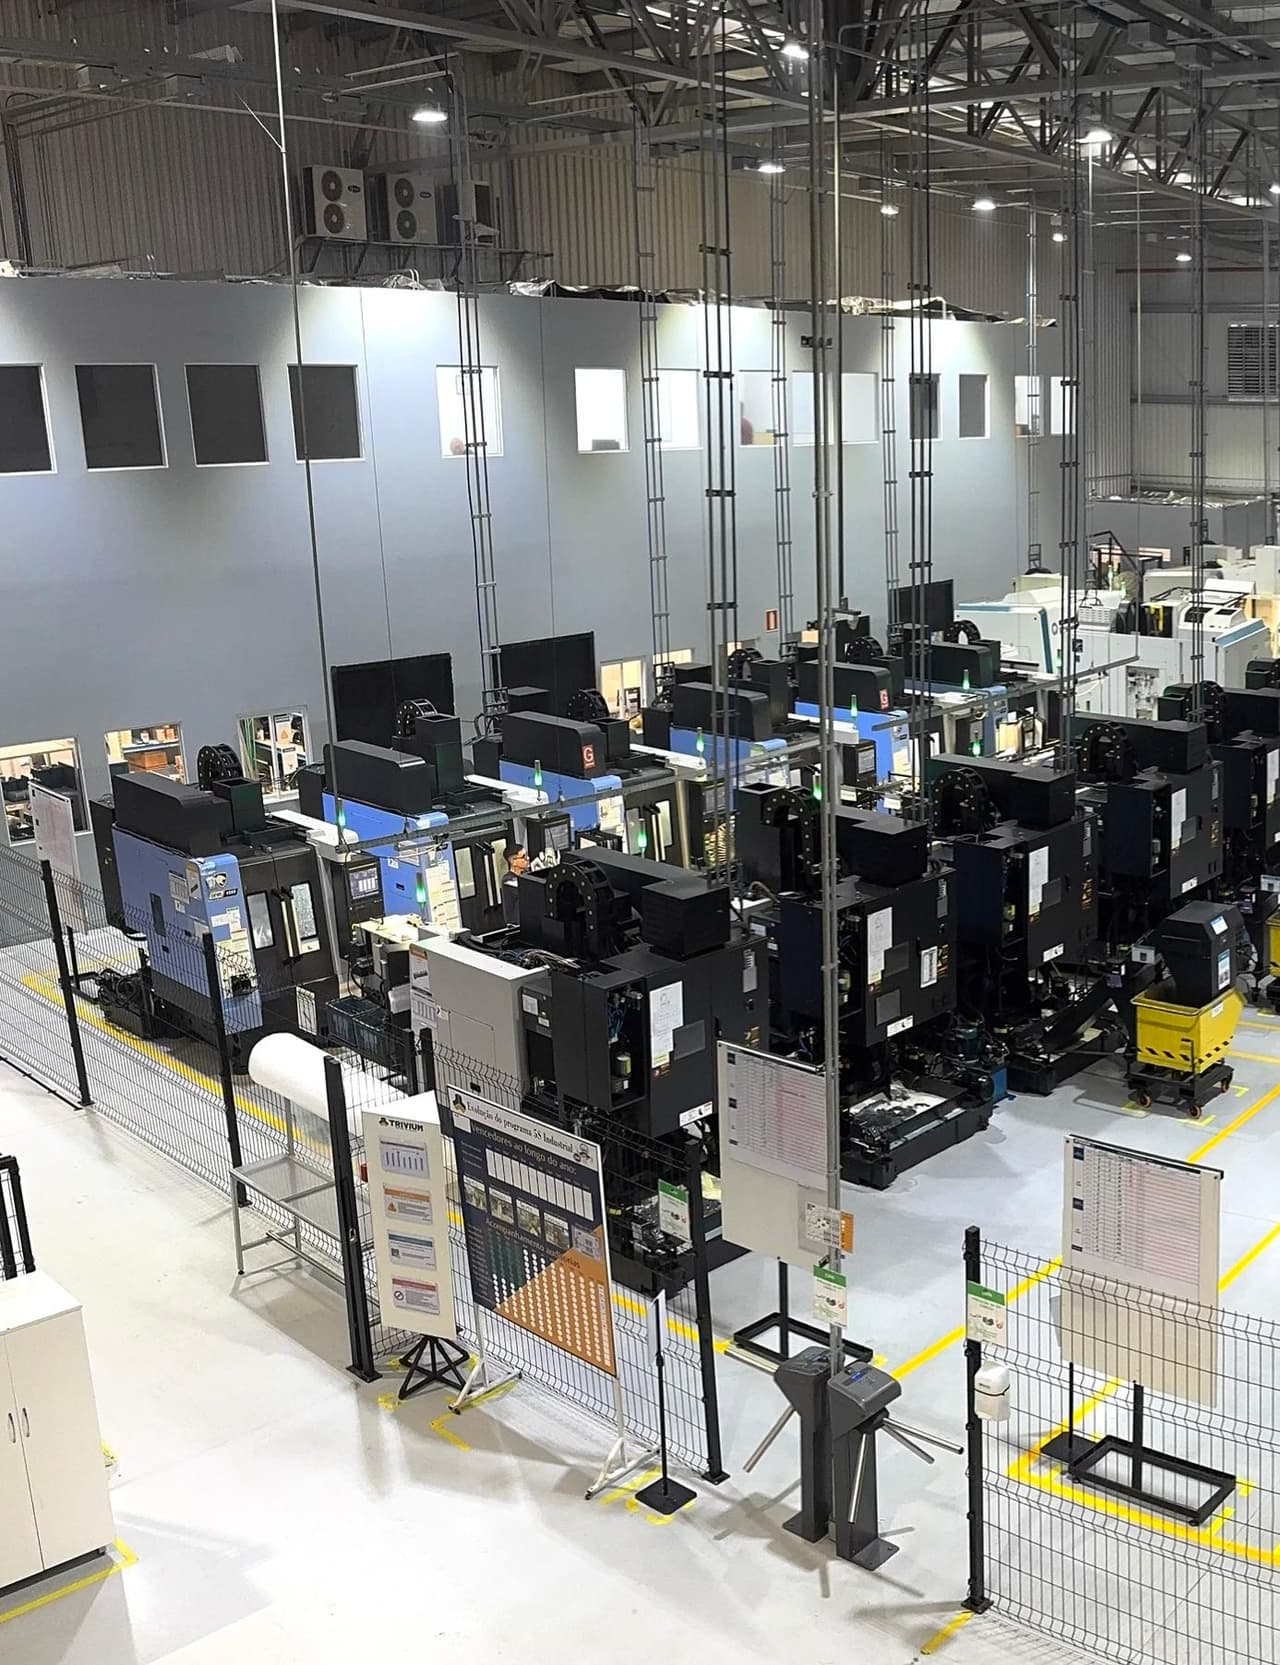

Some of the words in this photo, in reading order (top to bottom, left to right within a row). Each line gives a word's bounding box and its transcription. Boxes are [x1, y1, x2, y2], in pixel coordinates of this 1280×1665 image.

[390, 1119, 424, 1132] TRIVIUM
[503, 1118, 532, 1137] programa
[543, 1134, 574, 1153] Industrial
[471, 1122, 512, 1149] Vencedores
[524, 1145, 546, 1162] longo
[547, 1155, 558, 1168] do
